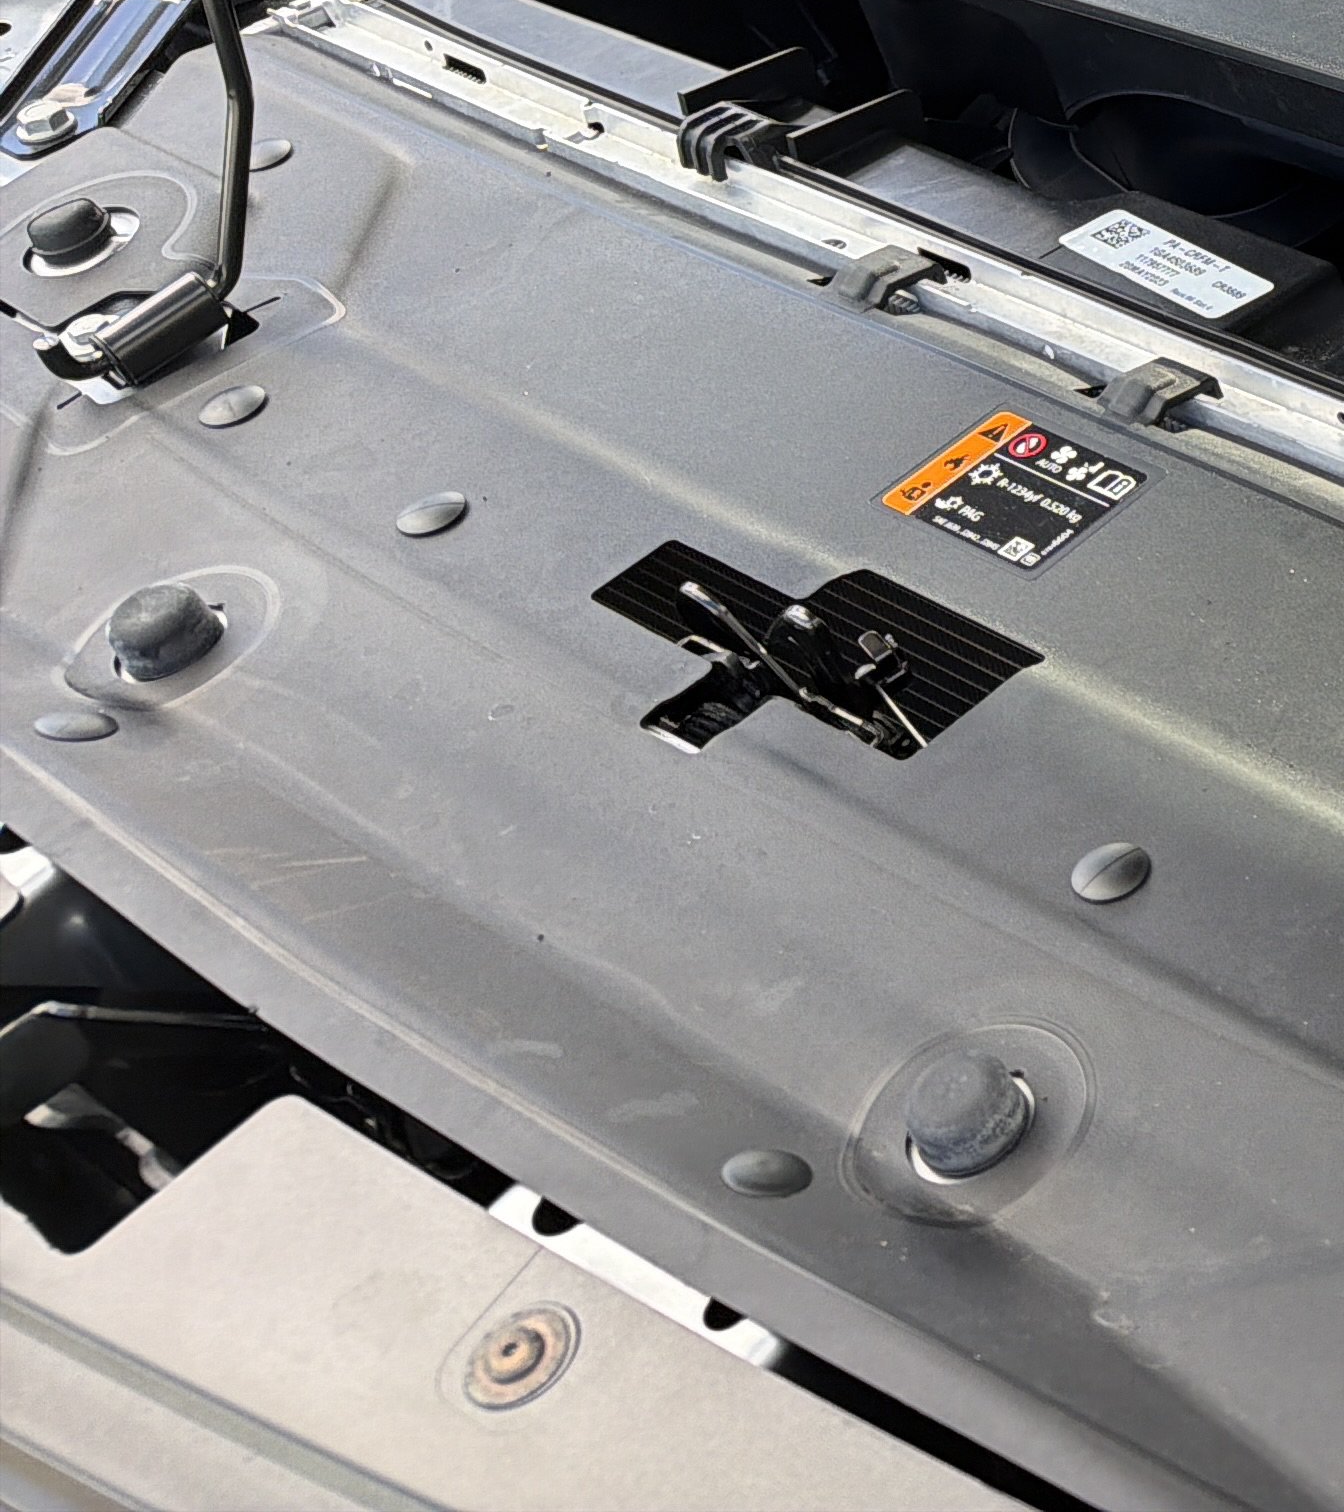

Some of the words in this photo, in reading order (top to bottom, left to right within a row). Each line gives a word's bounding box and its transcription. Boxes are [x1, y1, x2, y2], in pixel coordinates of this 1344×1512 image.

[1035, 458, 1062, 474] AUTO
[996, 477, 1043, 503] R-1234yf
[1066, 508, 1083, 524] kg
[958, 504, 985, 523] PAG
